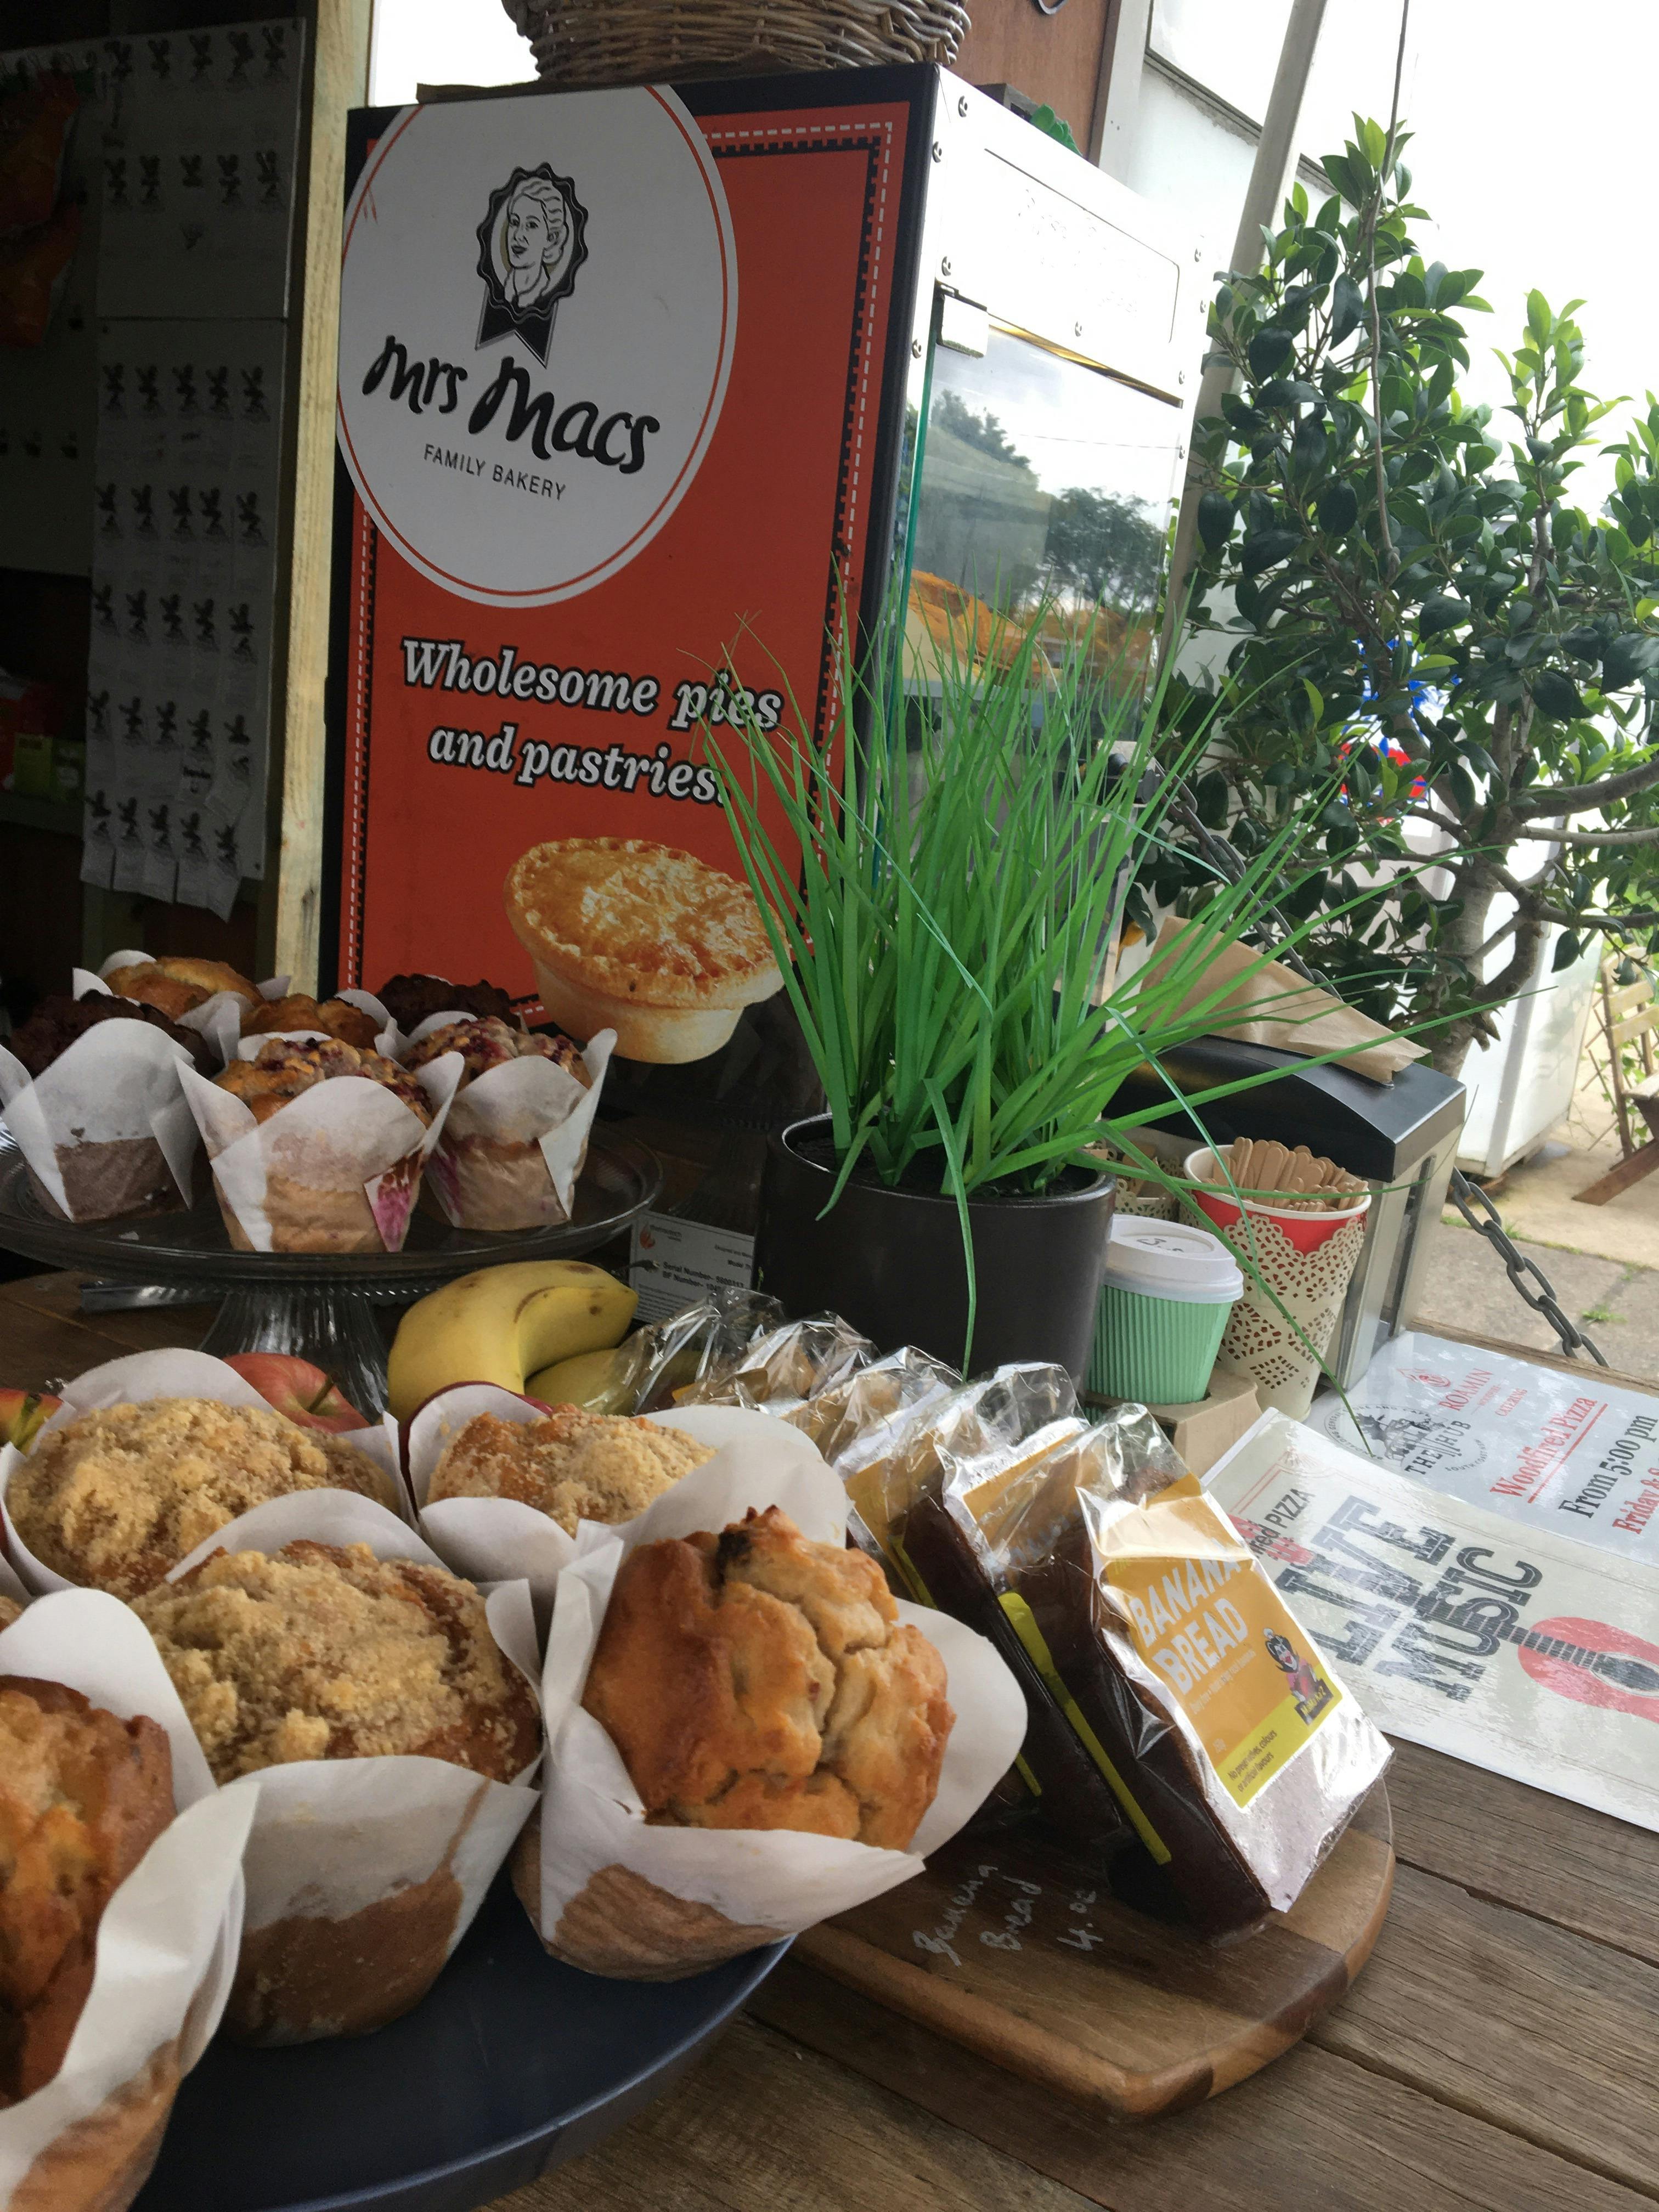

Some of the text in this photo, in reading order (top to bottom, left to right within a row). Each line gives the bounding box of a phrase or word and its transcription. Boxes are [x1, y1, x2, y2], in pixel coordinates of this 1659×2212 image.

[362, 335, 660, 474] Mrs Macs
[424, 444, 567, 501] FAMILY BAKERY
[402, 637, 784, 731] Wholesome pies
[428, 723, 517, 770] and
[1438, 1368, 1494, 1412] ROAMIN
[1405, 1420, 1472, 1475] THE HUB
[1489, 1397, 1598, 1498] Woodfired Pizza
[1558, 1415, 1658, 1520] From 5:00 pm
[1263, 1488, 1316, 1530] PIZZA
[1275, 1495, 1457, 1666] LIVE
[1373, 1546, 1543, 1703] MUSIC
[1153, 1598, 1248, 1695] BREAD
[979, 1875, 1042, 1951] Bread
